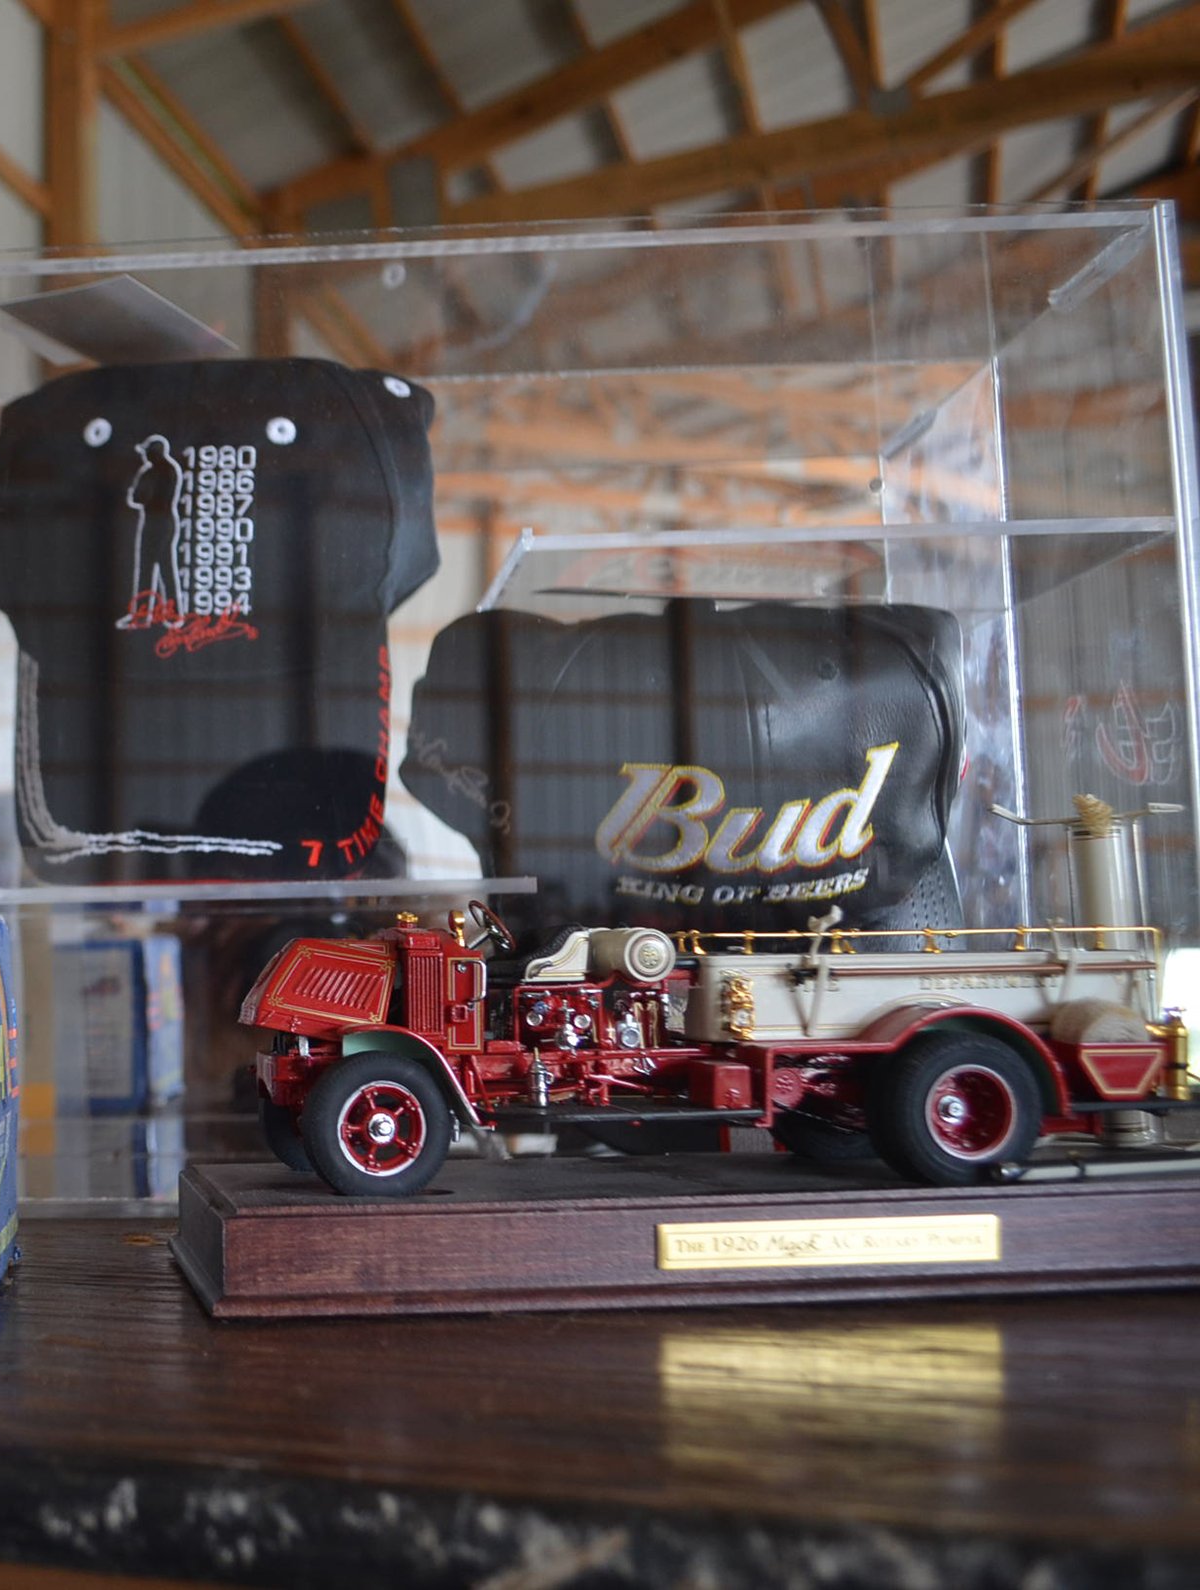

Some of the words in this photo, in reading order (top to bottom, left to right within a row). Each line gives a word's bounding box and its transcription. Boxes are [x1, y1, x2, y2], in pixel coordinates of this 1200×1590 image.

[182, 445, 257, 470] 1980
[182, 469, 255, 494] 1986
[180, 493, 254, 518] 1987
[179, 517, 254, 543] 1990
[179, 541, 248, 566] 1991
[179, 565, 251, 591] 1993
[180, 590, 252, 616] 1994
[595, 740, 900, 873] Bud
[302, 840, 324, 867] 7
[337, 793, 385, 865] TIME
[616, 875, 704, 904] KING
[712, 884, 760, 905] OF
[763, 867, 870, 902] BEERS
